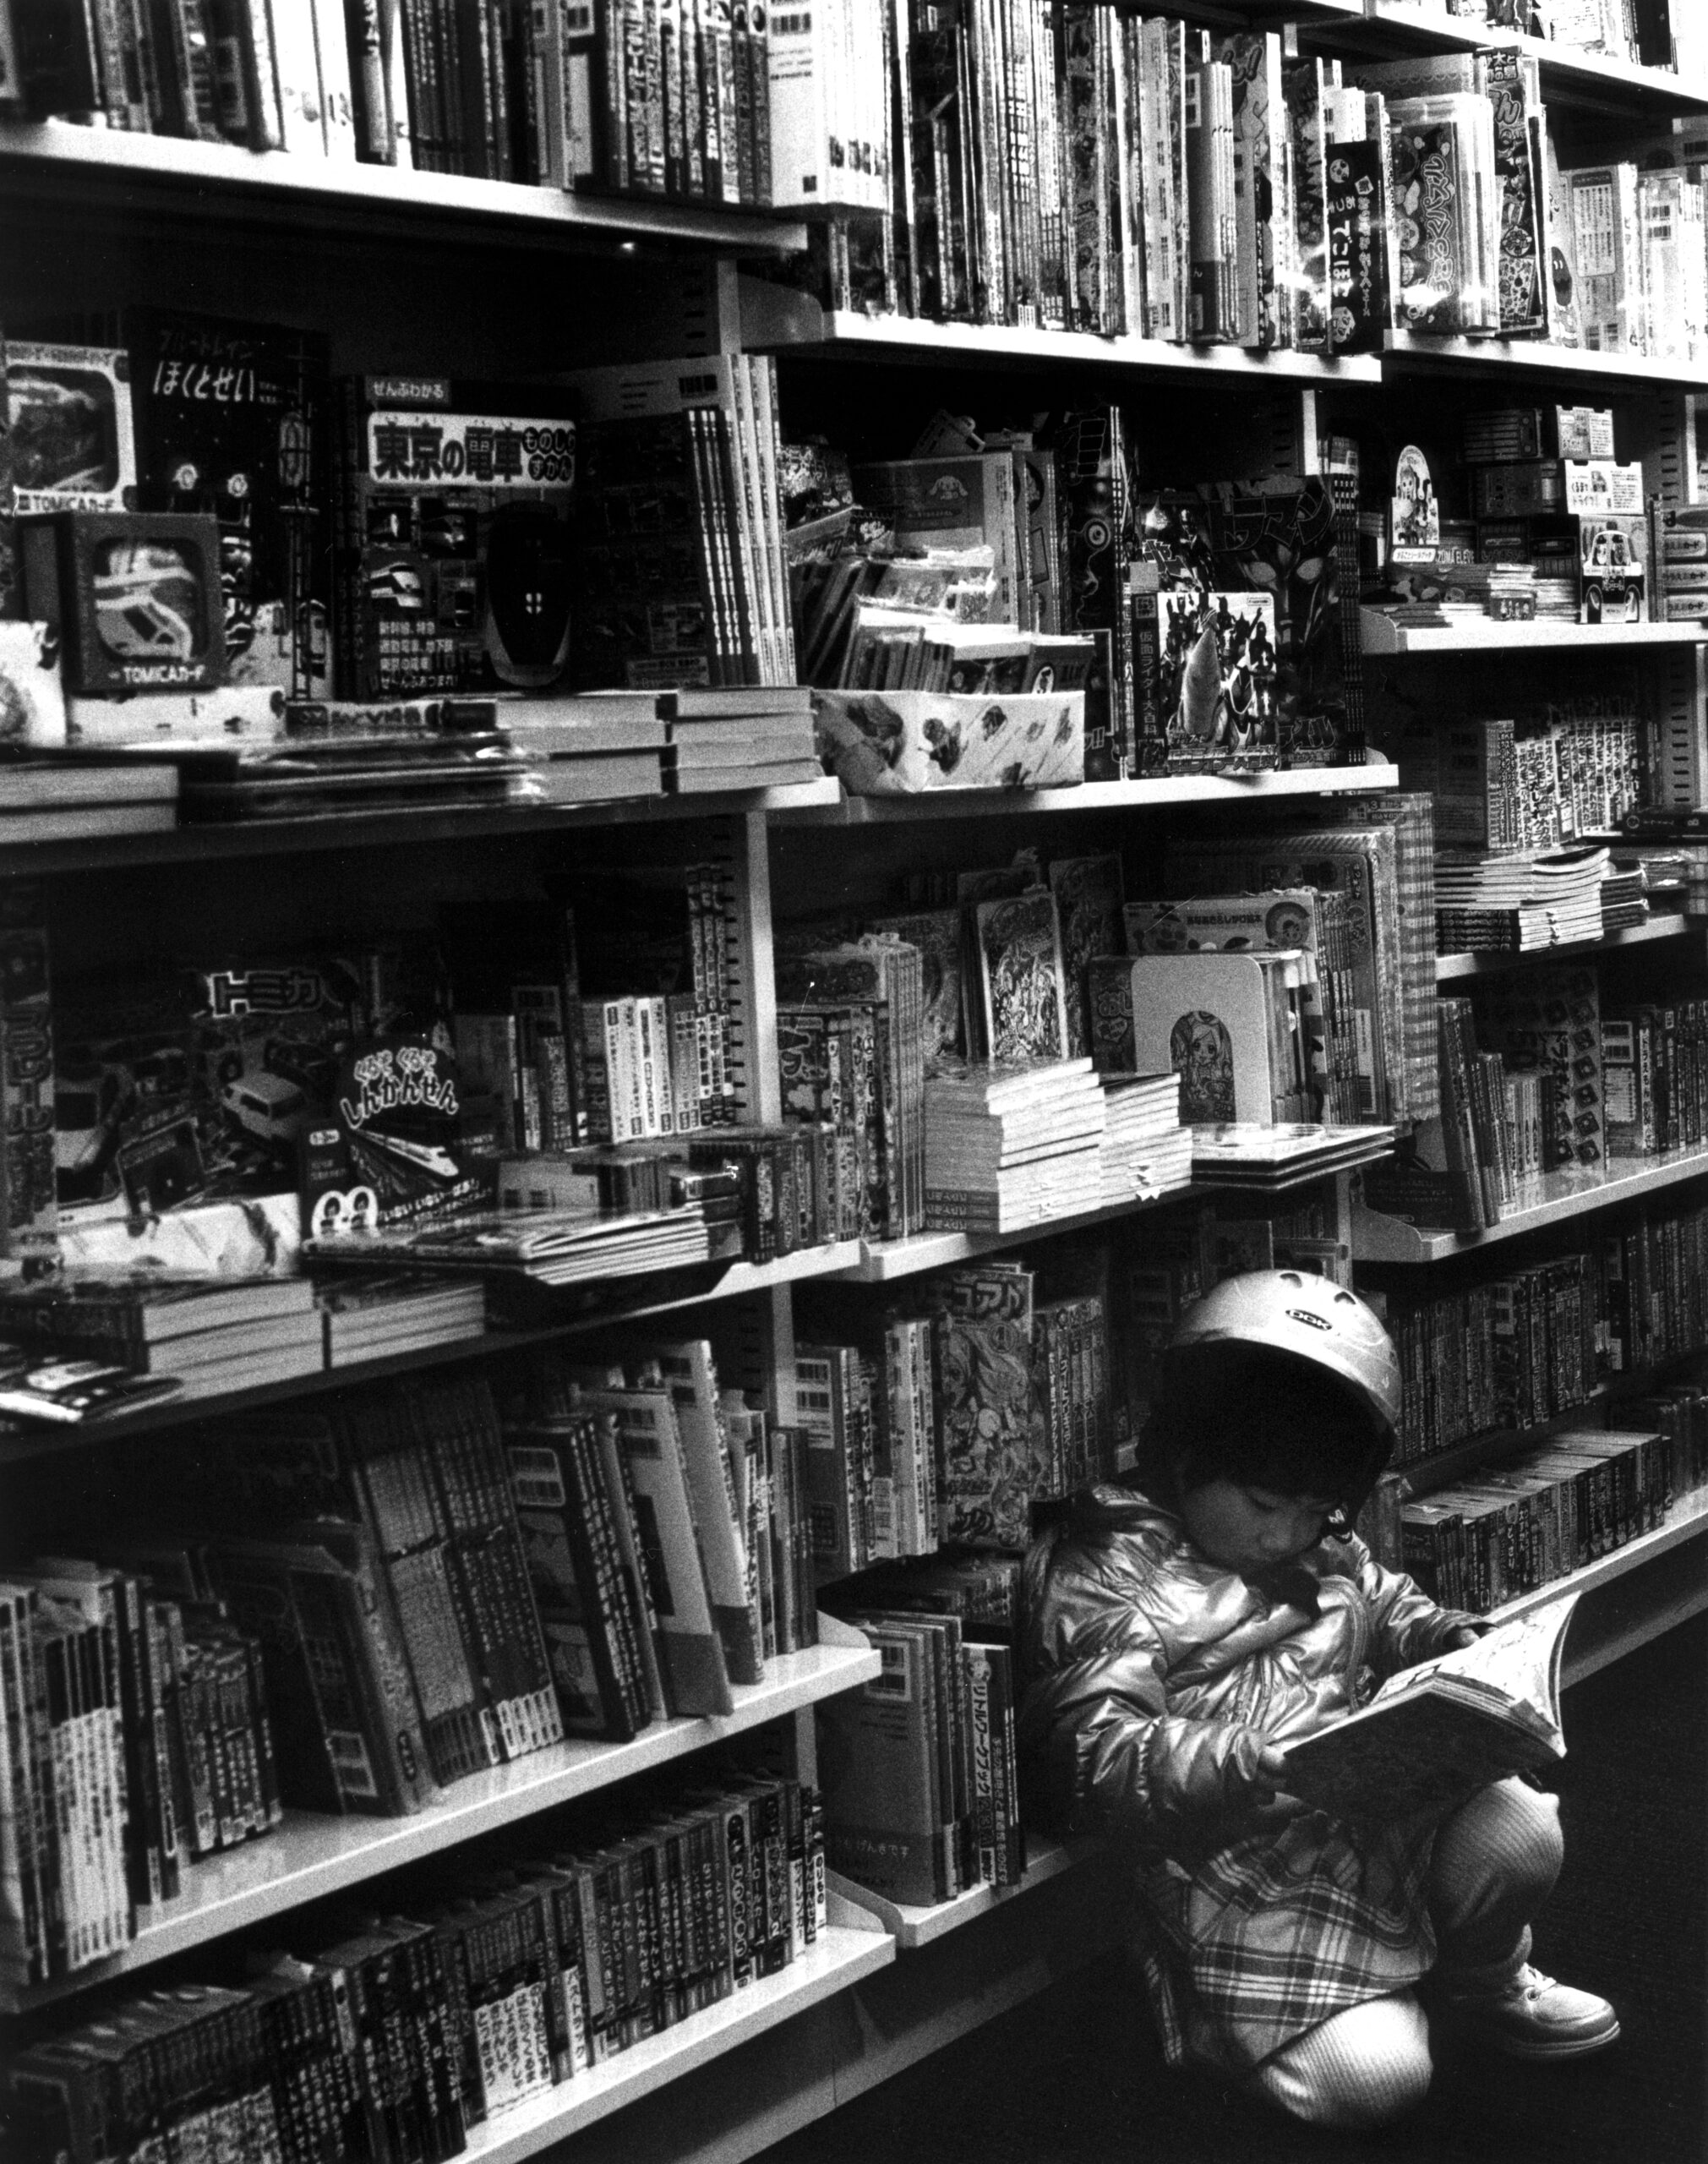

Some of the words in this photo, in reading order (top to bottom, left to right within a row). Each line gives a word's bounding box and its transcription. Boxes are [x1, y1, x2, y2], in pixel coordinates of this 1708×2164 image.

[154, 361, 254, 402] ほくとせい
[374, 381, 445, 399] ぜんぶわかる
[374, 422, 523, 483] 東京の電車
[210, 971, 325, 1017] トミカ
[340, 1072, 459, 1129] しんかんせん
[1289, 1310, 1330, 1331] OGK
[973, 1685, 990, 1795] リトルワークブック
